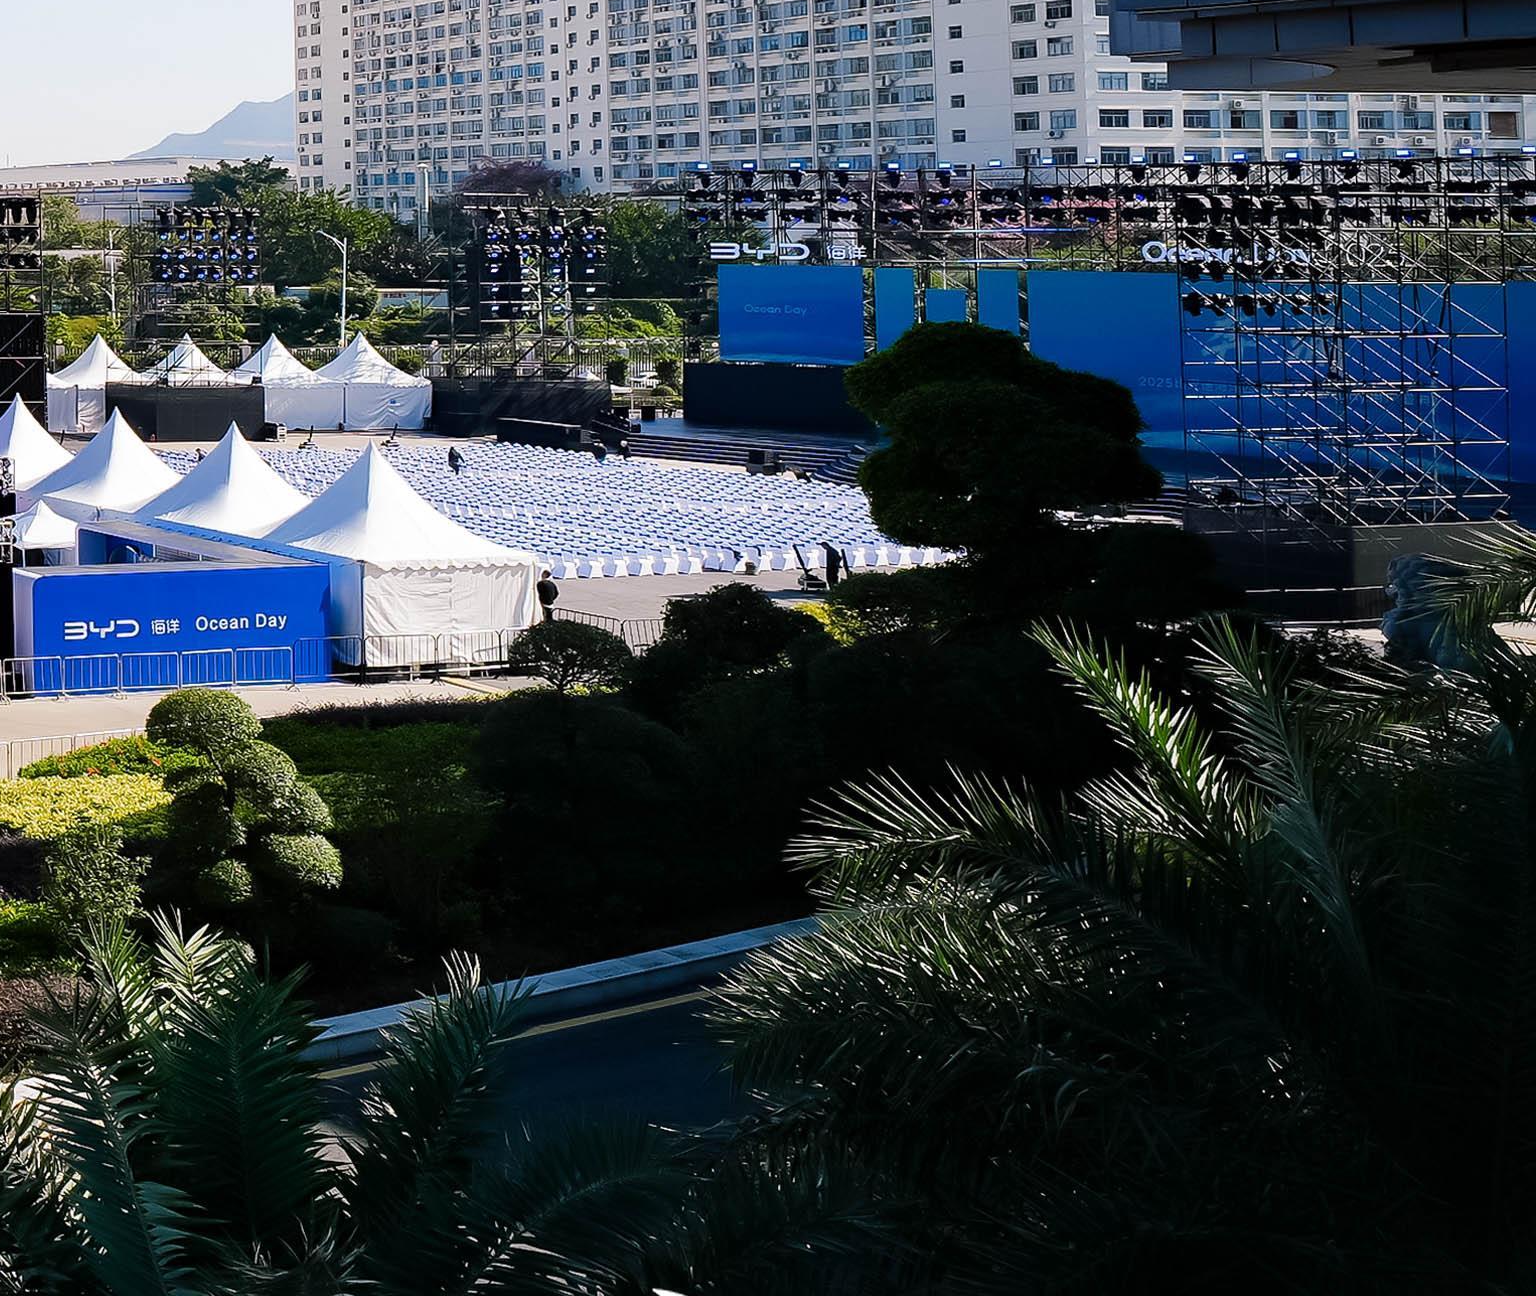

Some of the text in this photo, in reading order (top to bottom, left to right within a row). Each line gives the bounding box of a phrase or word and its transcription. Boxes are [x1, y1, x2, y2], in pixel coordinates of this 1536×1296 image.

[709, 242, 810, 260] BYD
[744, 304, 808, 317] Ocean Day
[64, 612, 287, 640] BYD 海洋 Ocean Day
